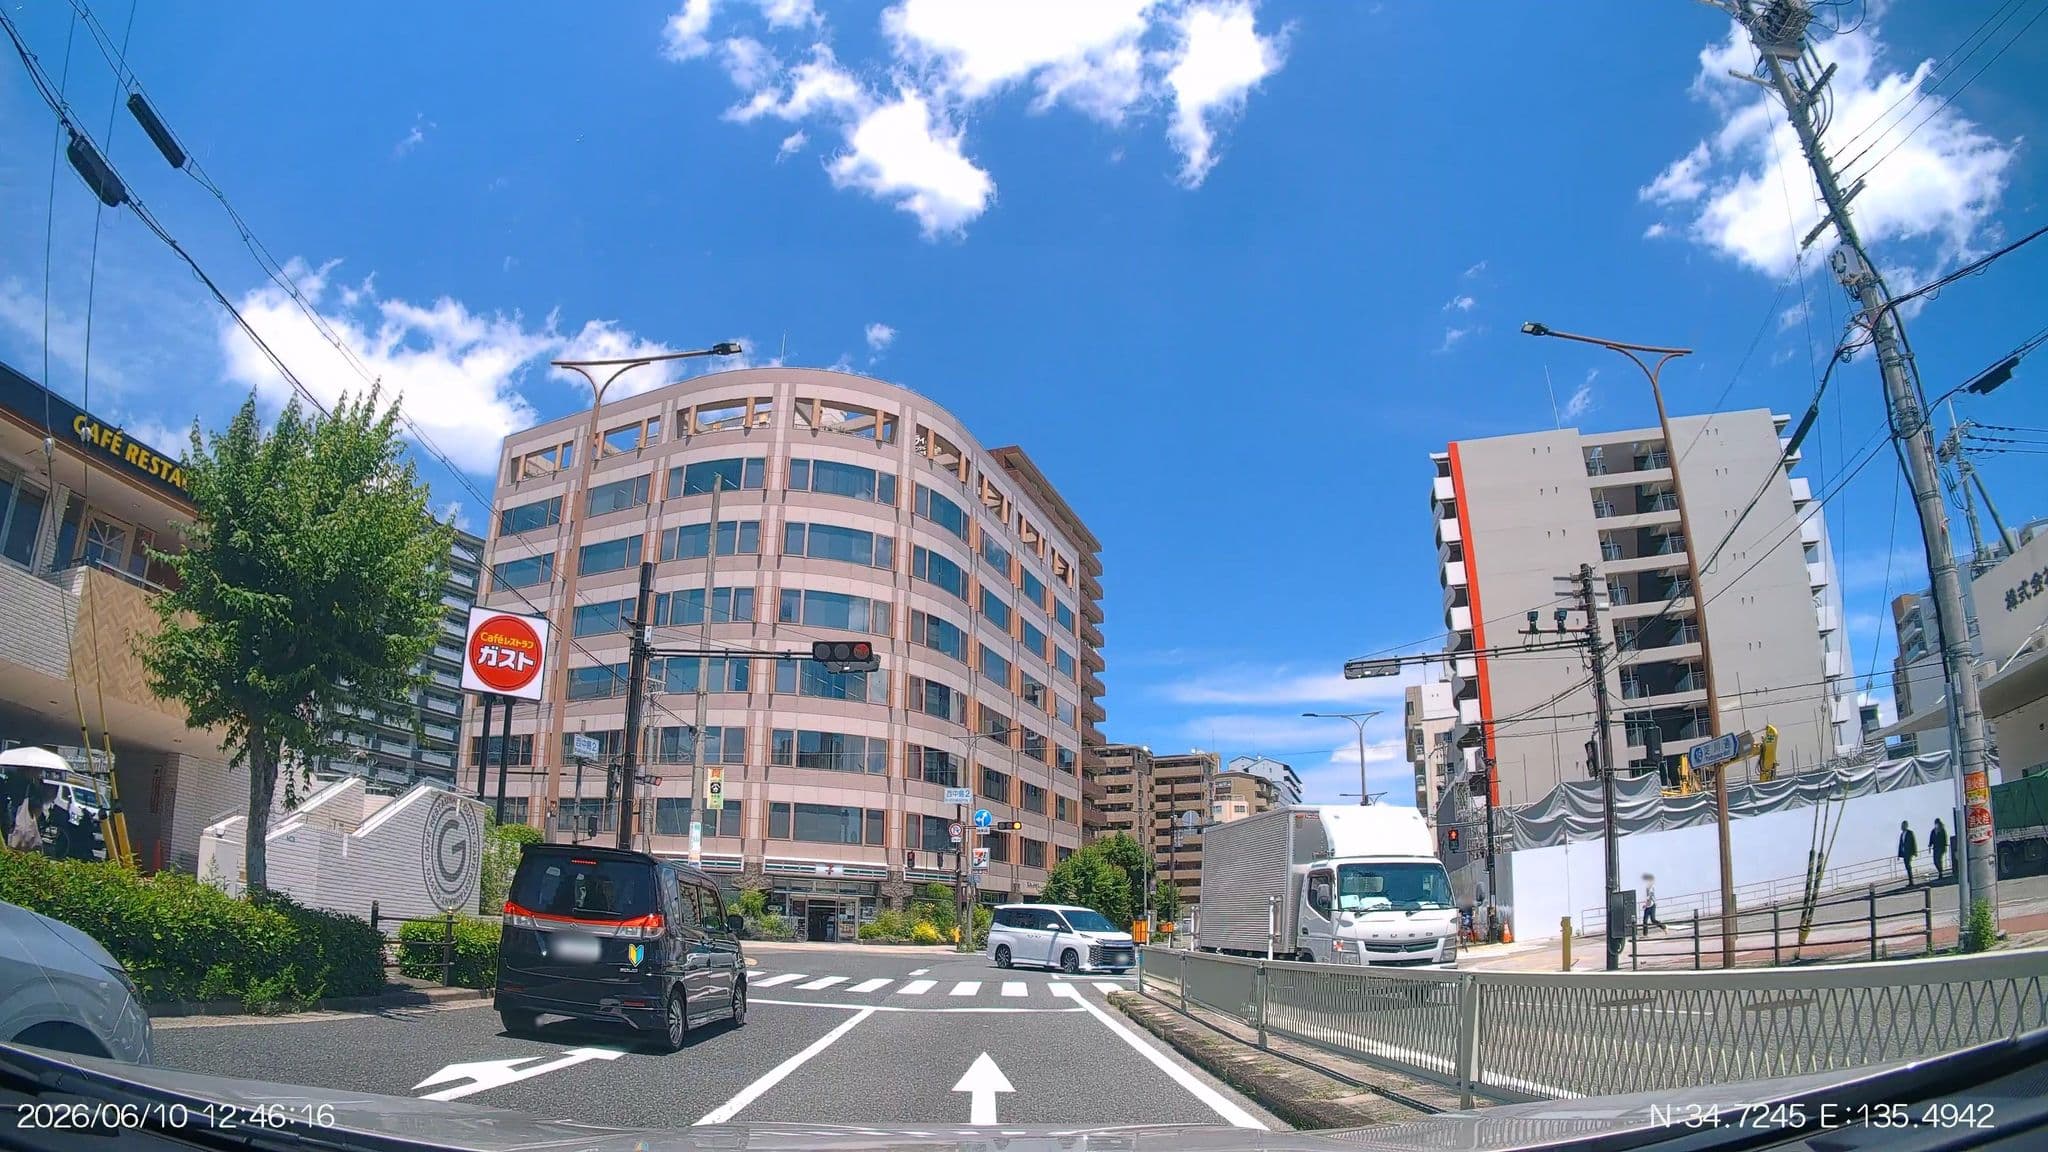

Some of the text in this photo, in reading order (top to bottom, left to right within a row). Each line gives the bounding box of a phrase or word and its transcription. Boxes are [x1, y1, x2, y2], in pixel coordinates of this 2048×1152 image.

[73, 415, 123, 456] CAFÉ
[477, 645, 535, 671] ガスト
[946, 789, 970, 798] 西中島2
